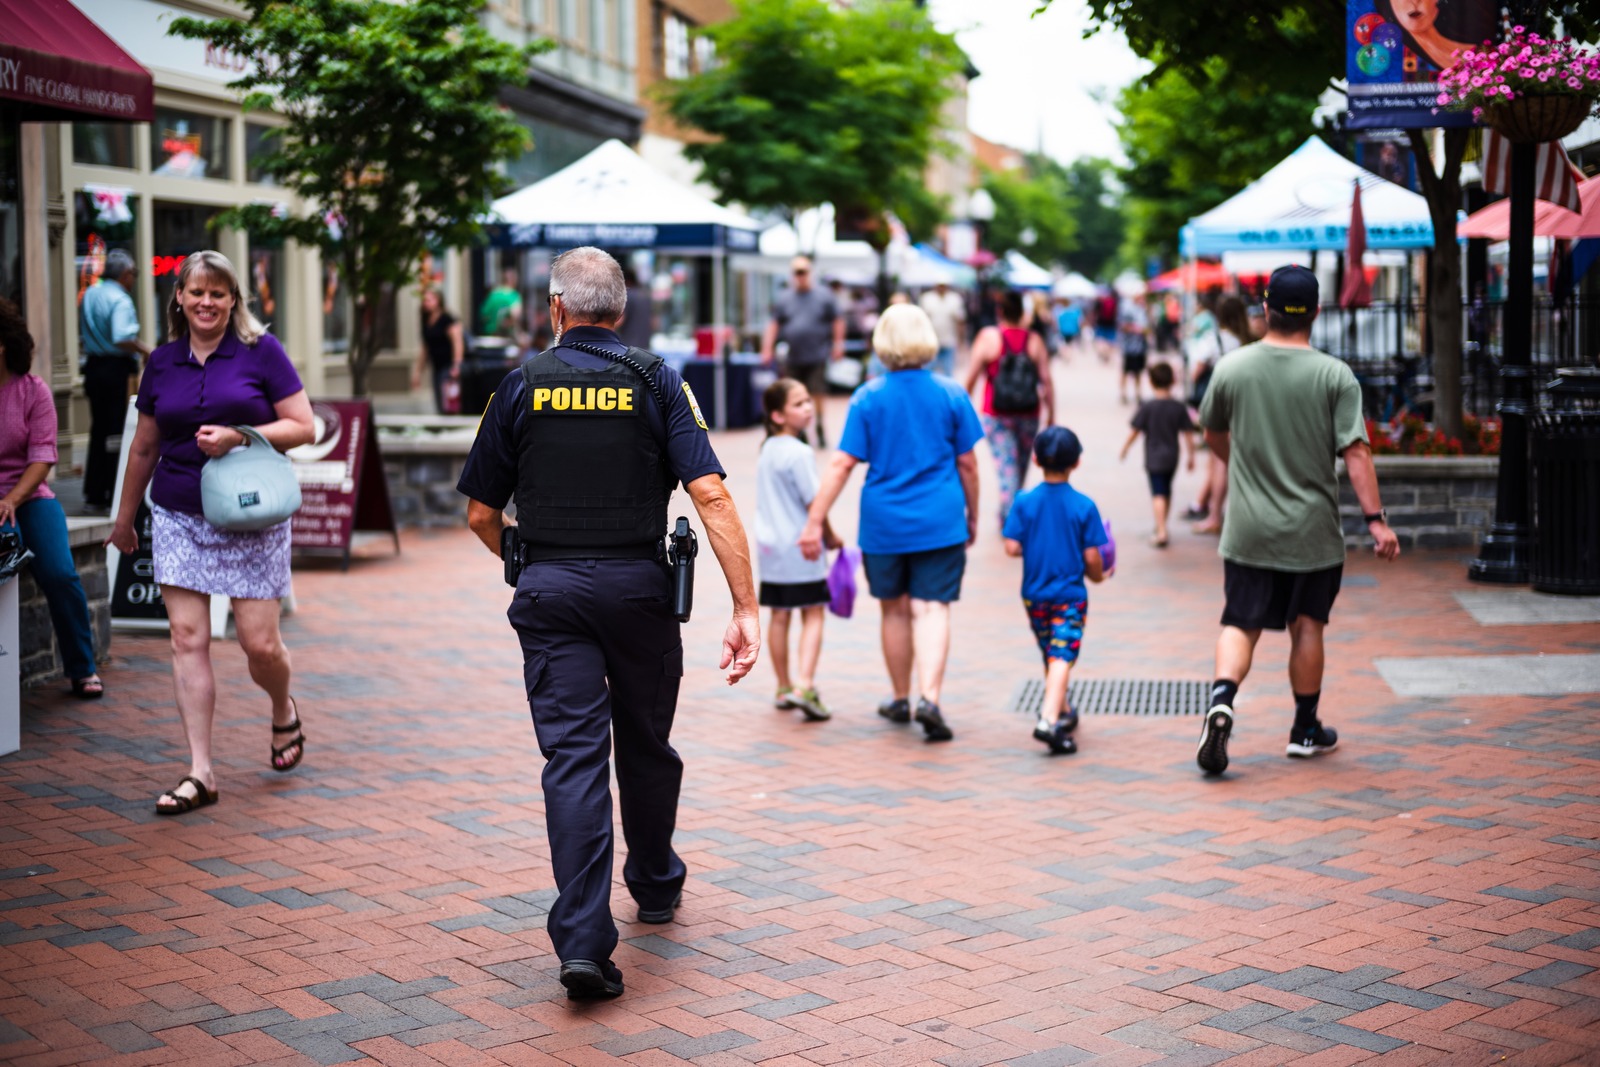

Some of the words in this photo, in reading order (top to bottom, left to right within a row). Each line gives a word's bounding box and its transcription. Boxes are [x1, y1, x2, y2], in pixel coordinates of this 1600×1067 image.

[0, 57, 20, 91] RY
[24, 74, 44, 97] FINE
[45, 79, 80, 105] GLOBAL
[533, 387, 633, 411] POLICE
[127, 582, 164, 604] OP
